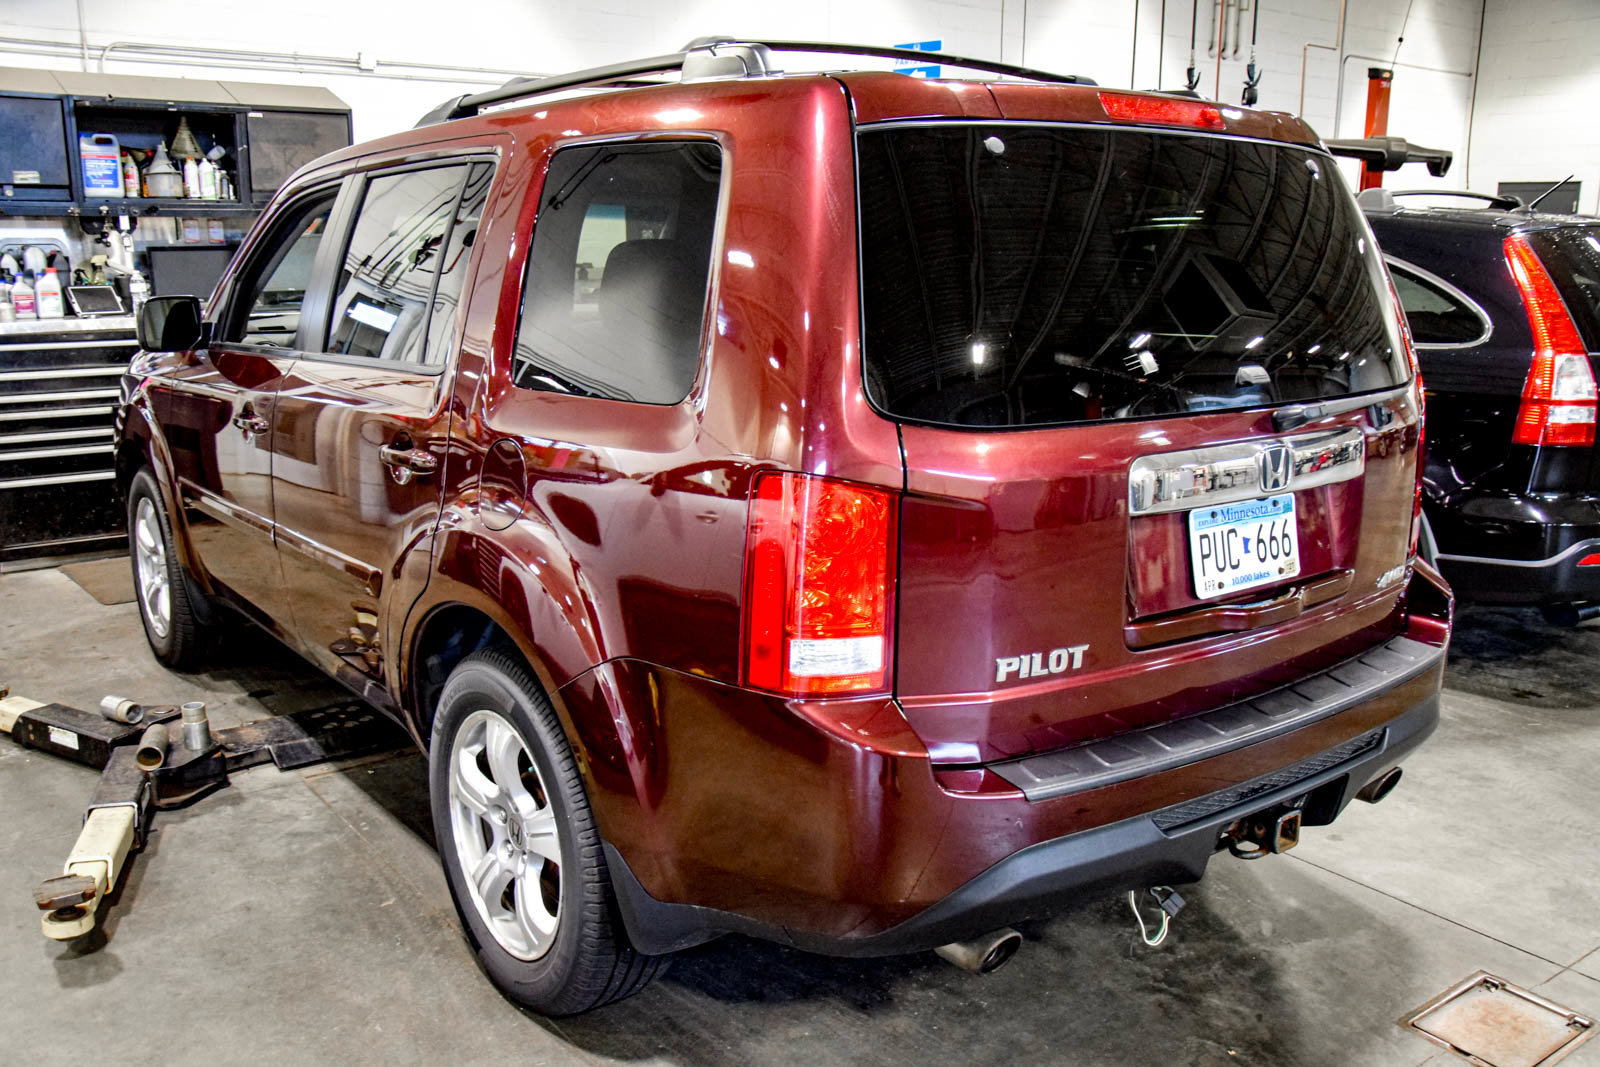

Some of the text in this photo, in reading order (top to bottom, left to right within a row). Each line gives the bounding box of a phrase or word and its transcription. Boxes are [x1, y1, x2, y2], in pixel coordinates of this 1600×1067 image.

[1199, 519, 1292, 577] PUC 666
[1231, 570, 1271, 587] 10,000 lakes
[995, 643, 1090, 683] PILOT
